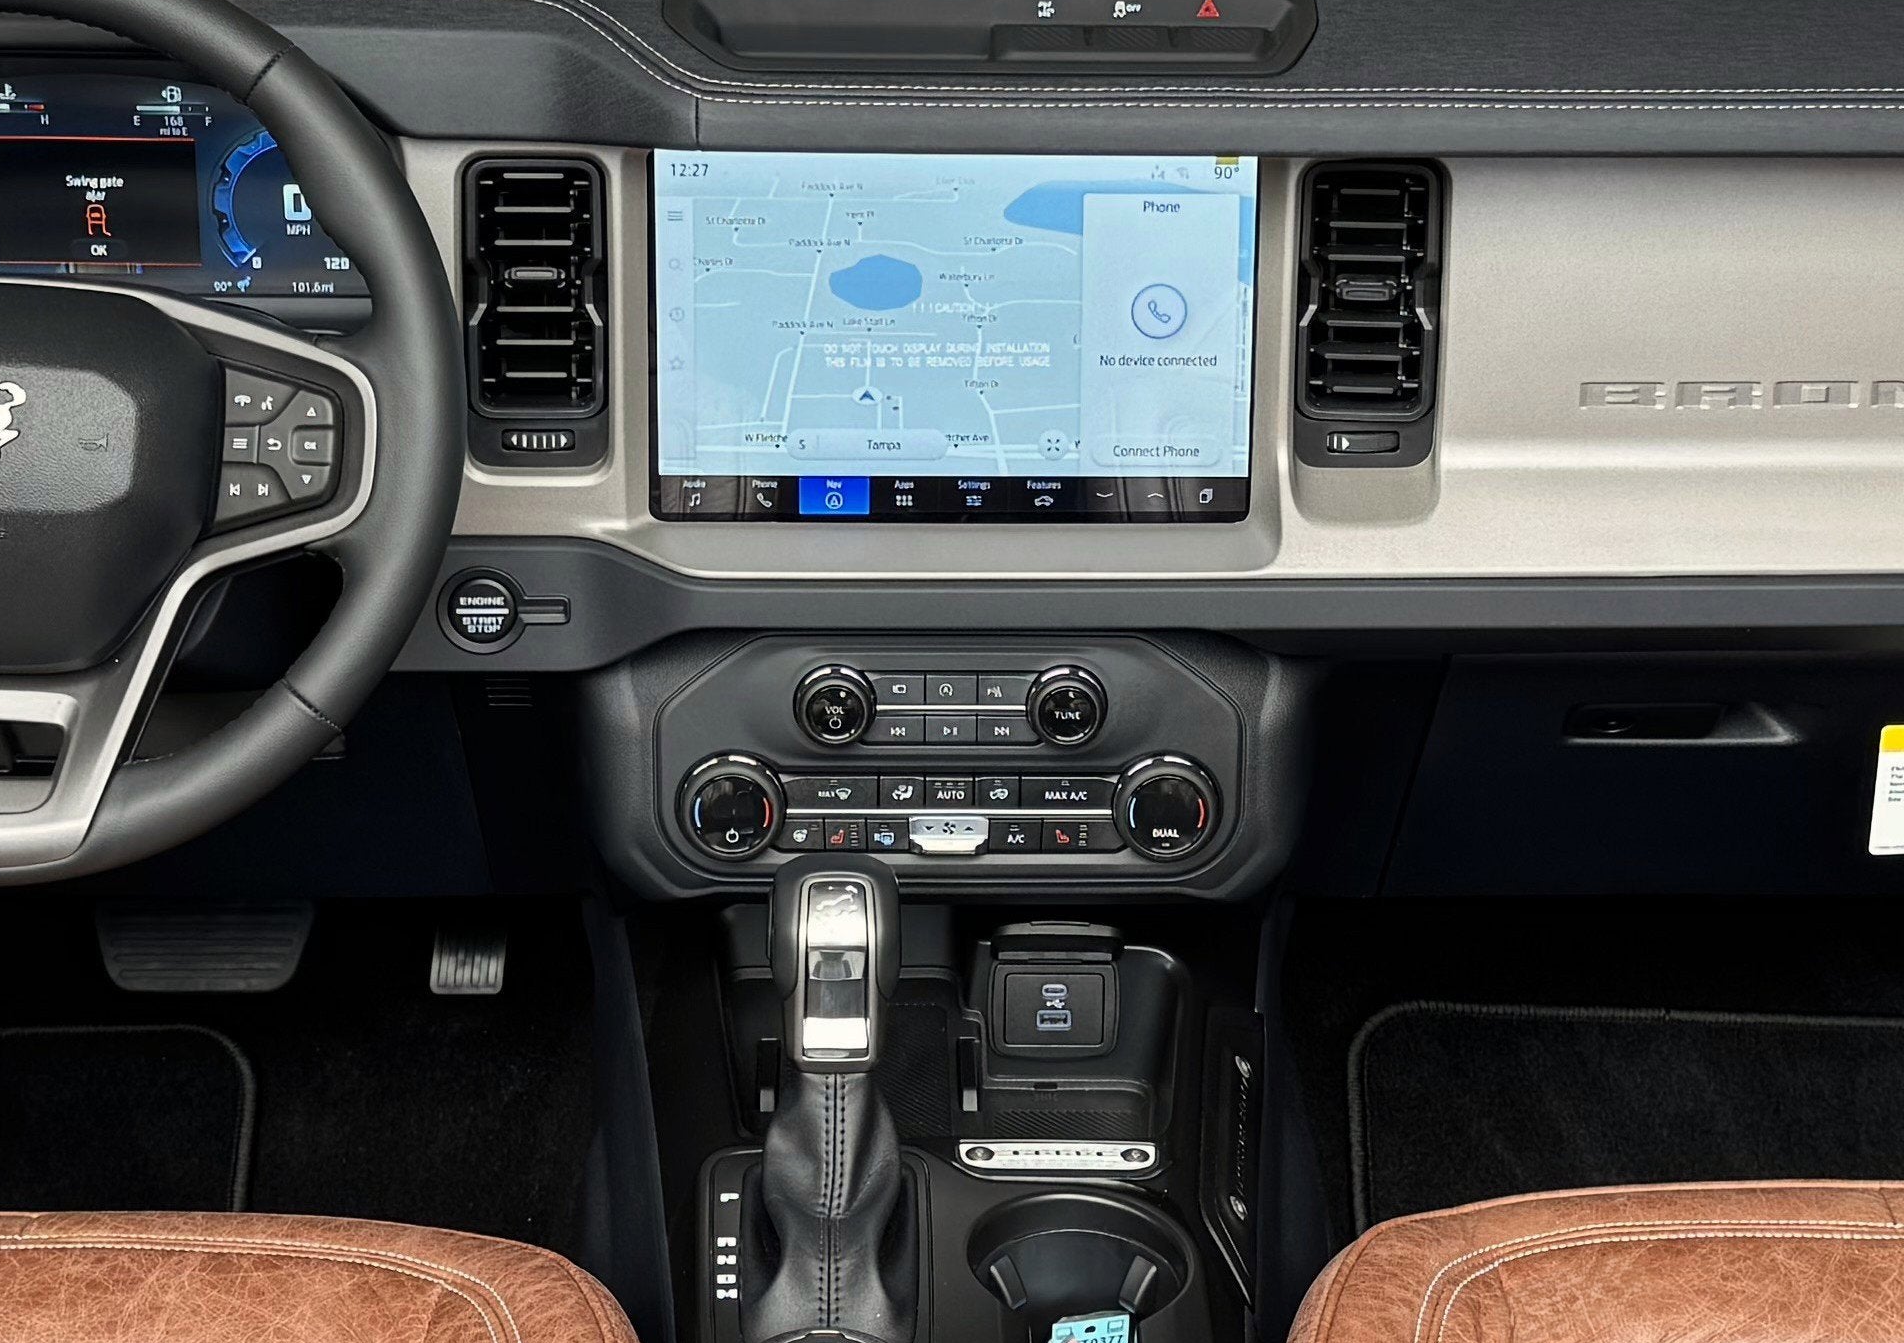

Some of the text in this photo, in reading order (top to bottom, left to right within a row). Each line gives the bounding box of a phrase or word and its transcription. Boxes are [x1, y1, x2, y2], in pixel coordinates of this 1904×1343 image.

[41, 115, 49, 125] H
[133, 116, 141, 126] E
[205, 116, 212, 126] F
[670, 163, 709, 177] 12:27
[1213, 166, 1240, 179] 90°
[65, 175, 123, 189] Swing gate
[85, 190, 106, 202] ajar
[1143, 201, 1180, 214] Phone
[286, 224, 311, 236] MPH
[90, 245, 107, 256] OK
[252, 257, 262, 269] 0
[324, 257, 350, 270] 120
[1099, 354, 1217, 367] No device connected
[755, 433, 789, 443] Fletche
[798, 440, 806, 449] S
[867, 440, 901, 453] Tampa
[1113, 445, 1200, 458] Connect Phone
[1027, 480, 1061, 490] Features
[459, 596, 505, 606] ENGINE
[462, 616, 505, 625] START
[467, 625, 501, 633] STOP
[824, 705, 845, 715] VOL
[936, 789, 965, 800] AUTO
[1044, 790, 1088, 801] MAX A/C
[1007, 833, 1025, 845] A/C
[1152, 828, 1179, 839] DUAL
